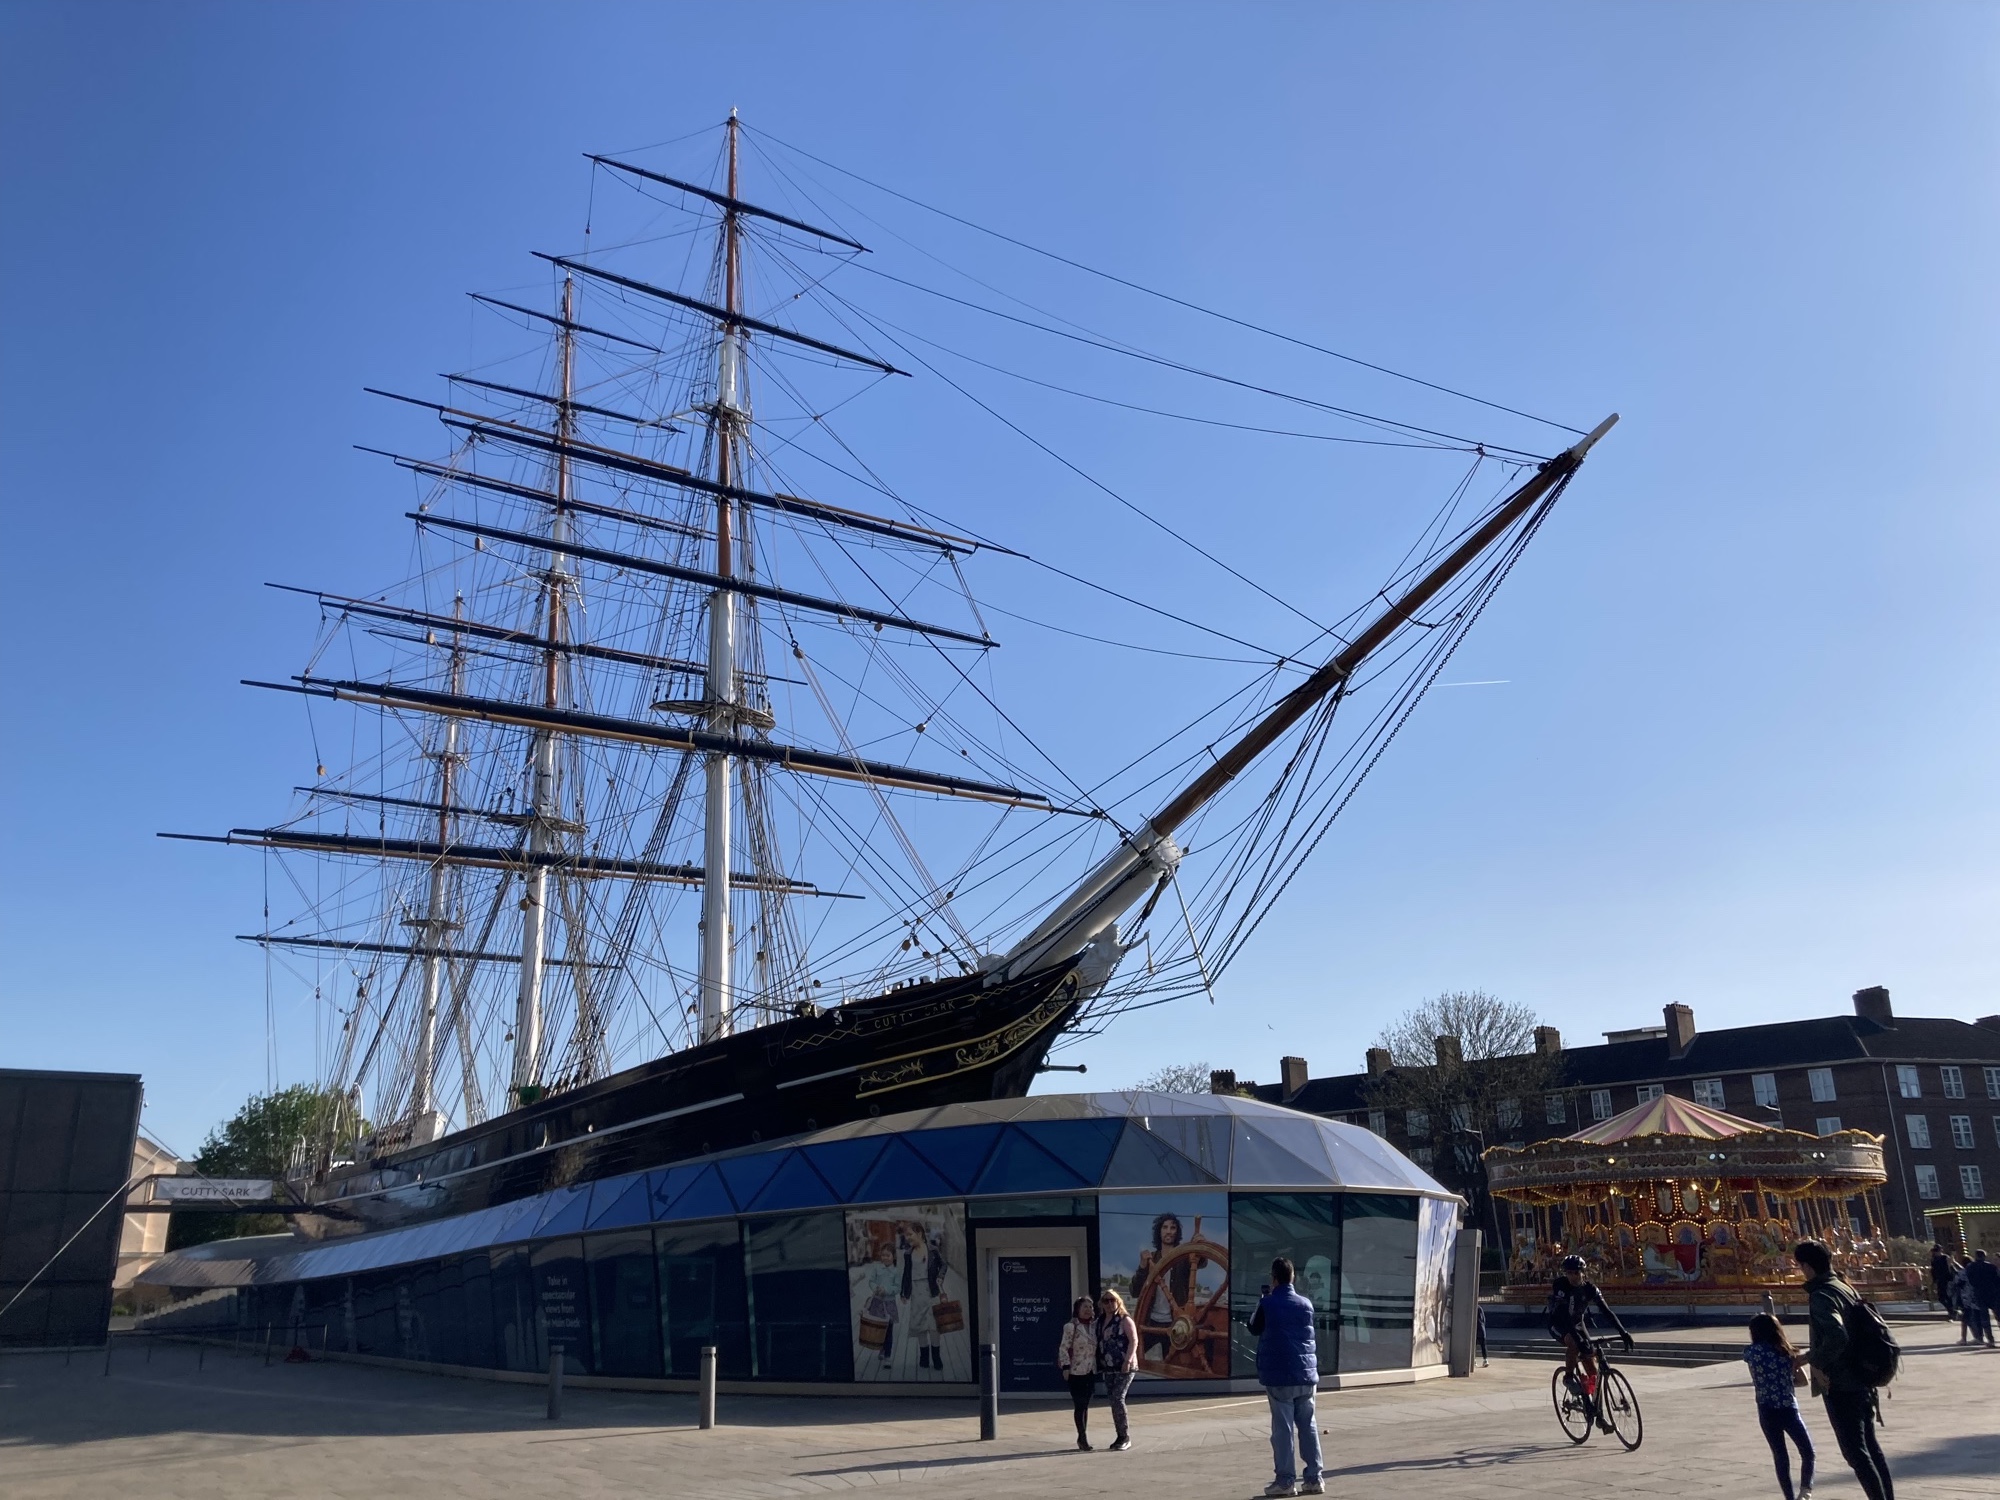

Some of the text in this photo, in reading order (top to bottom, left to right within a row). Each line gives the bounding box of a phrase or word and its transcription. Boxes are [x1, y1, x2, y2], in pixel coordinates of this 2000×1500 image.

[181, 1187, 219, 1196] CUTTY
[222, 1187, 250, 1196] SARK
[547, 1275, 568, 1286] Take in
[541, 1290, 576, 1301] spectacular
[1012, 1296, 1042, 1304] Entrance
[544, 1303, 575, 1313] views from
[1012, 1305, 1048, 1314] Cutty Sark
